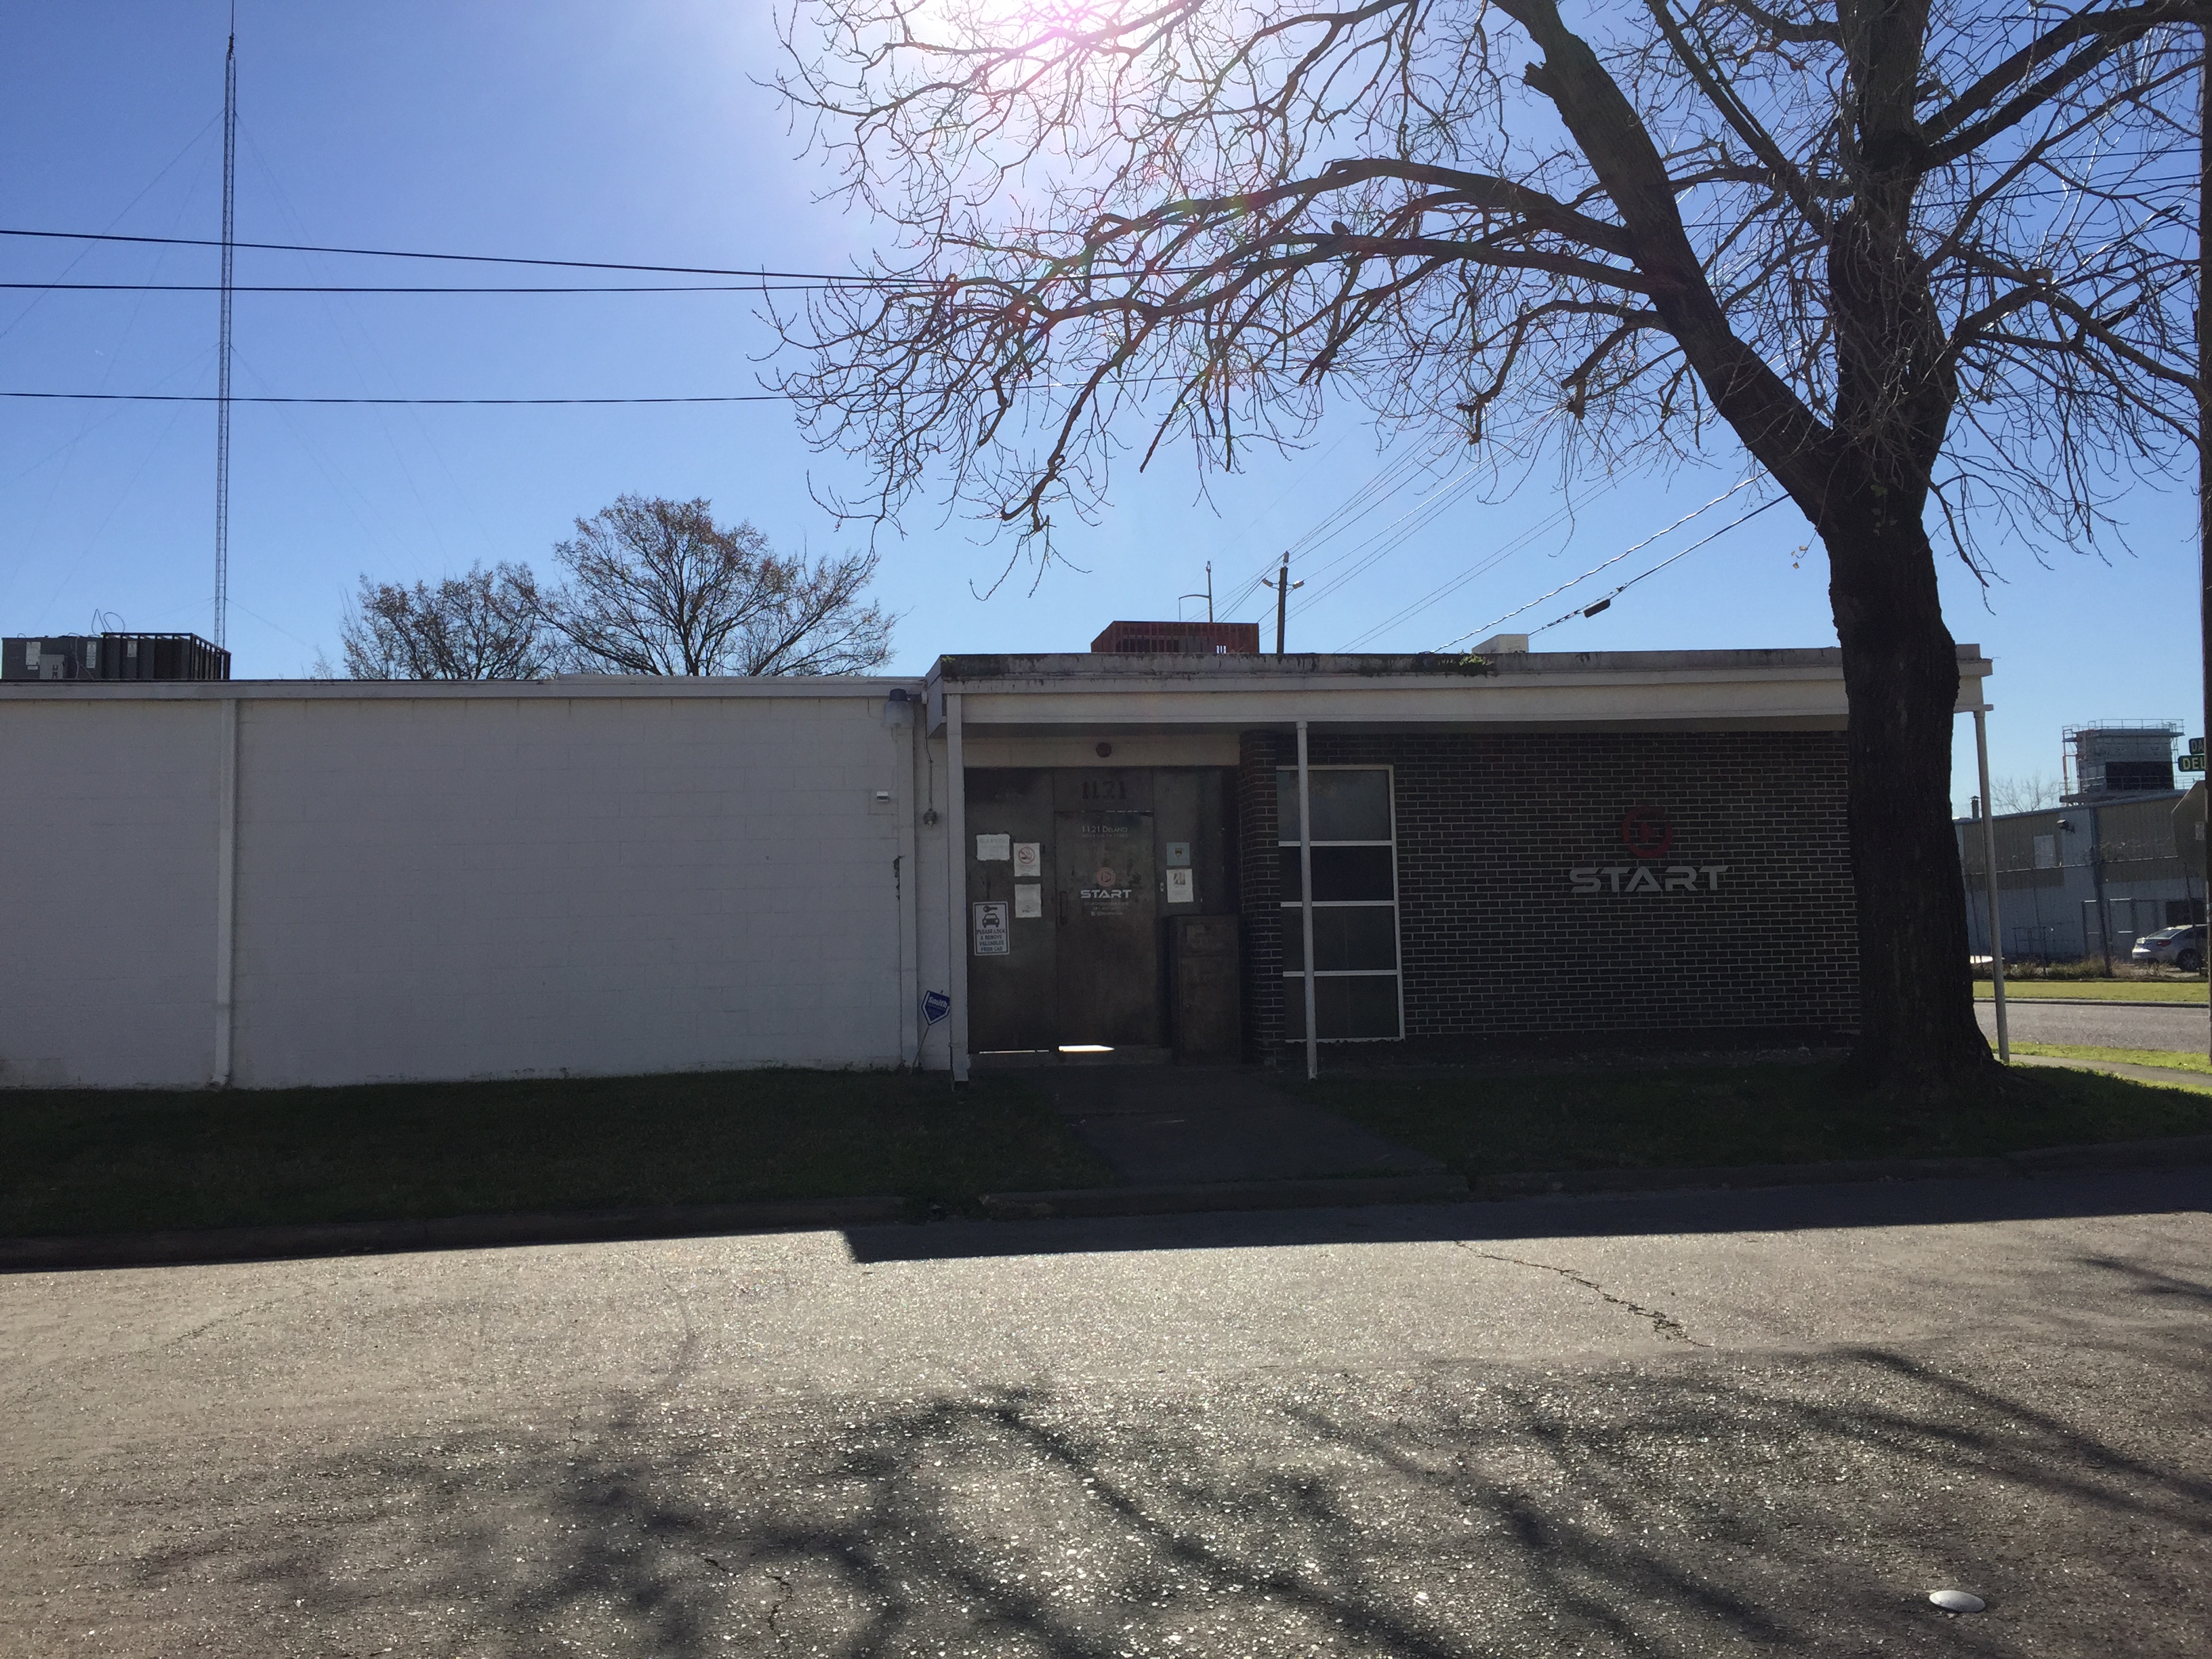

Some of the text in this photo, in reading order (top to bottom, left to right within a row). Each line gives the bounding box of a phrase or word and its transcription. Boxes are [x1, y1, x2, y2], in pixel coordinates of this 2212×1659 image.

[1082, 780, 1126, 799] 1121
[1082, 825, 1101, 833] 1121
[1569, 865, 1729, 893] START
[1080, 890, 1132, 898] START
